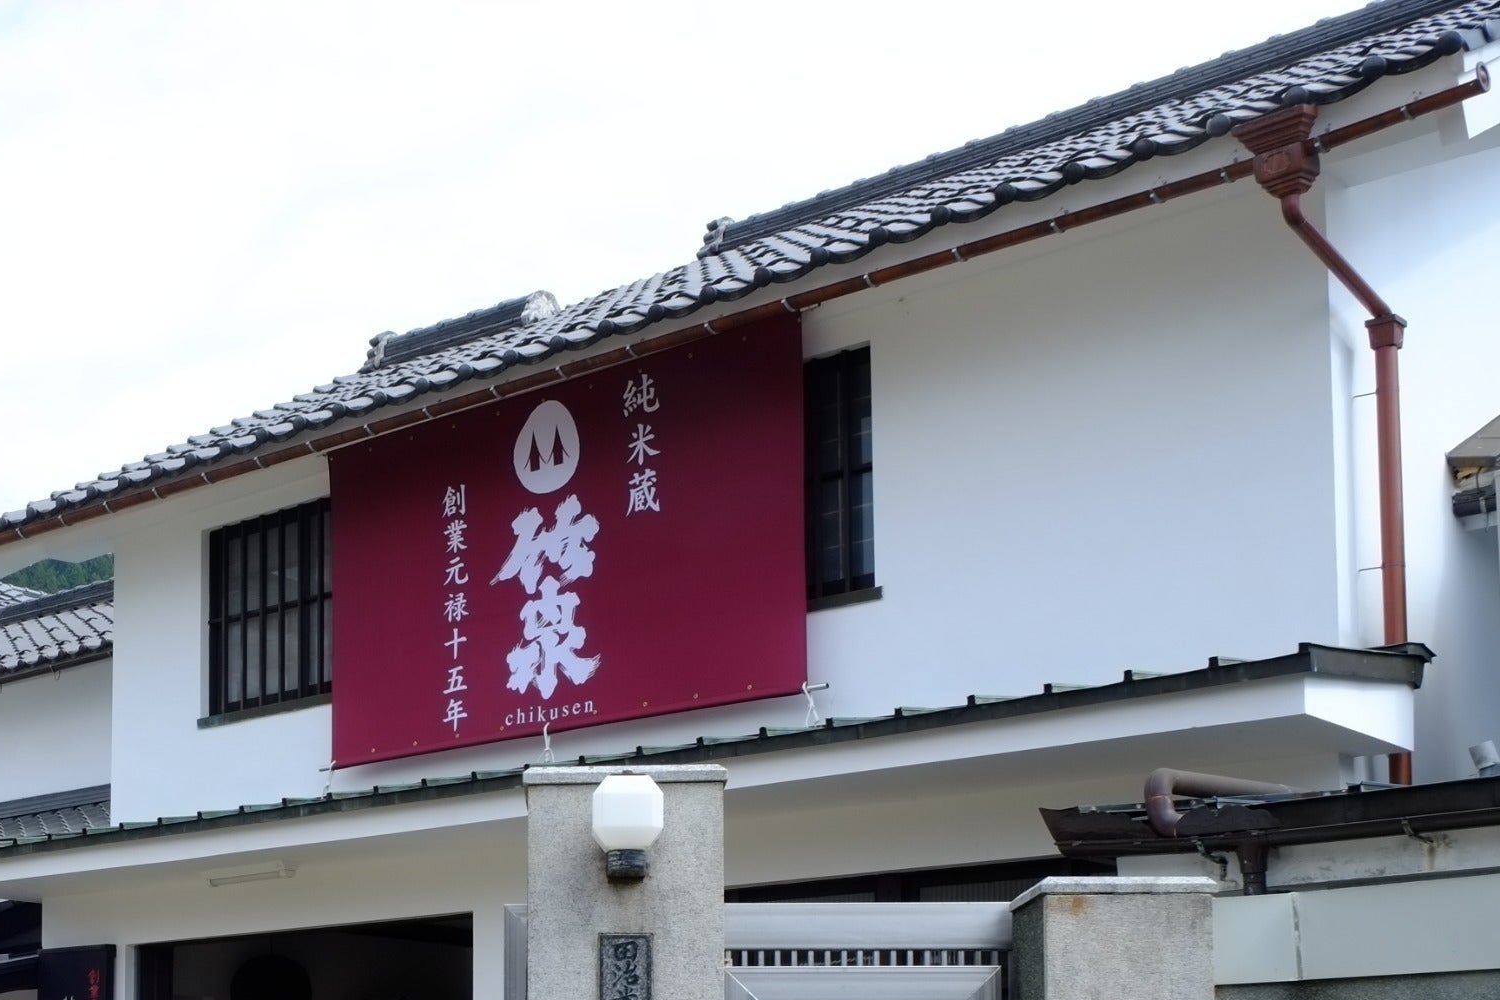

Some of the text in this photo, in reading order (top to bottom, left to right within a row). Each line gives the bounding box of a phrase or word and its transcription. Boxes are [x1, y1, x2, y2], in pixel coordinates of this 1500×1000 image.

[622, 373, 661, 518] 純米蔵
[441, 484, 469, 732] 創業元禄十五年
[490, 494, 601, 700] 竹泉
[504, 699, 595, 727] chikusen
